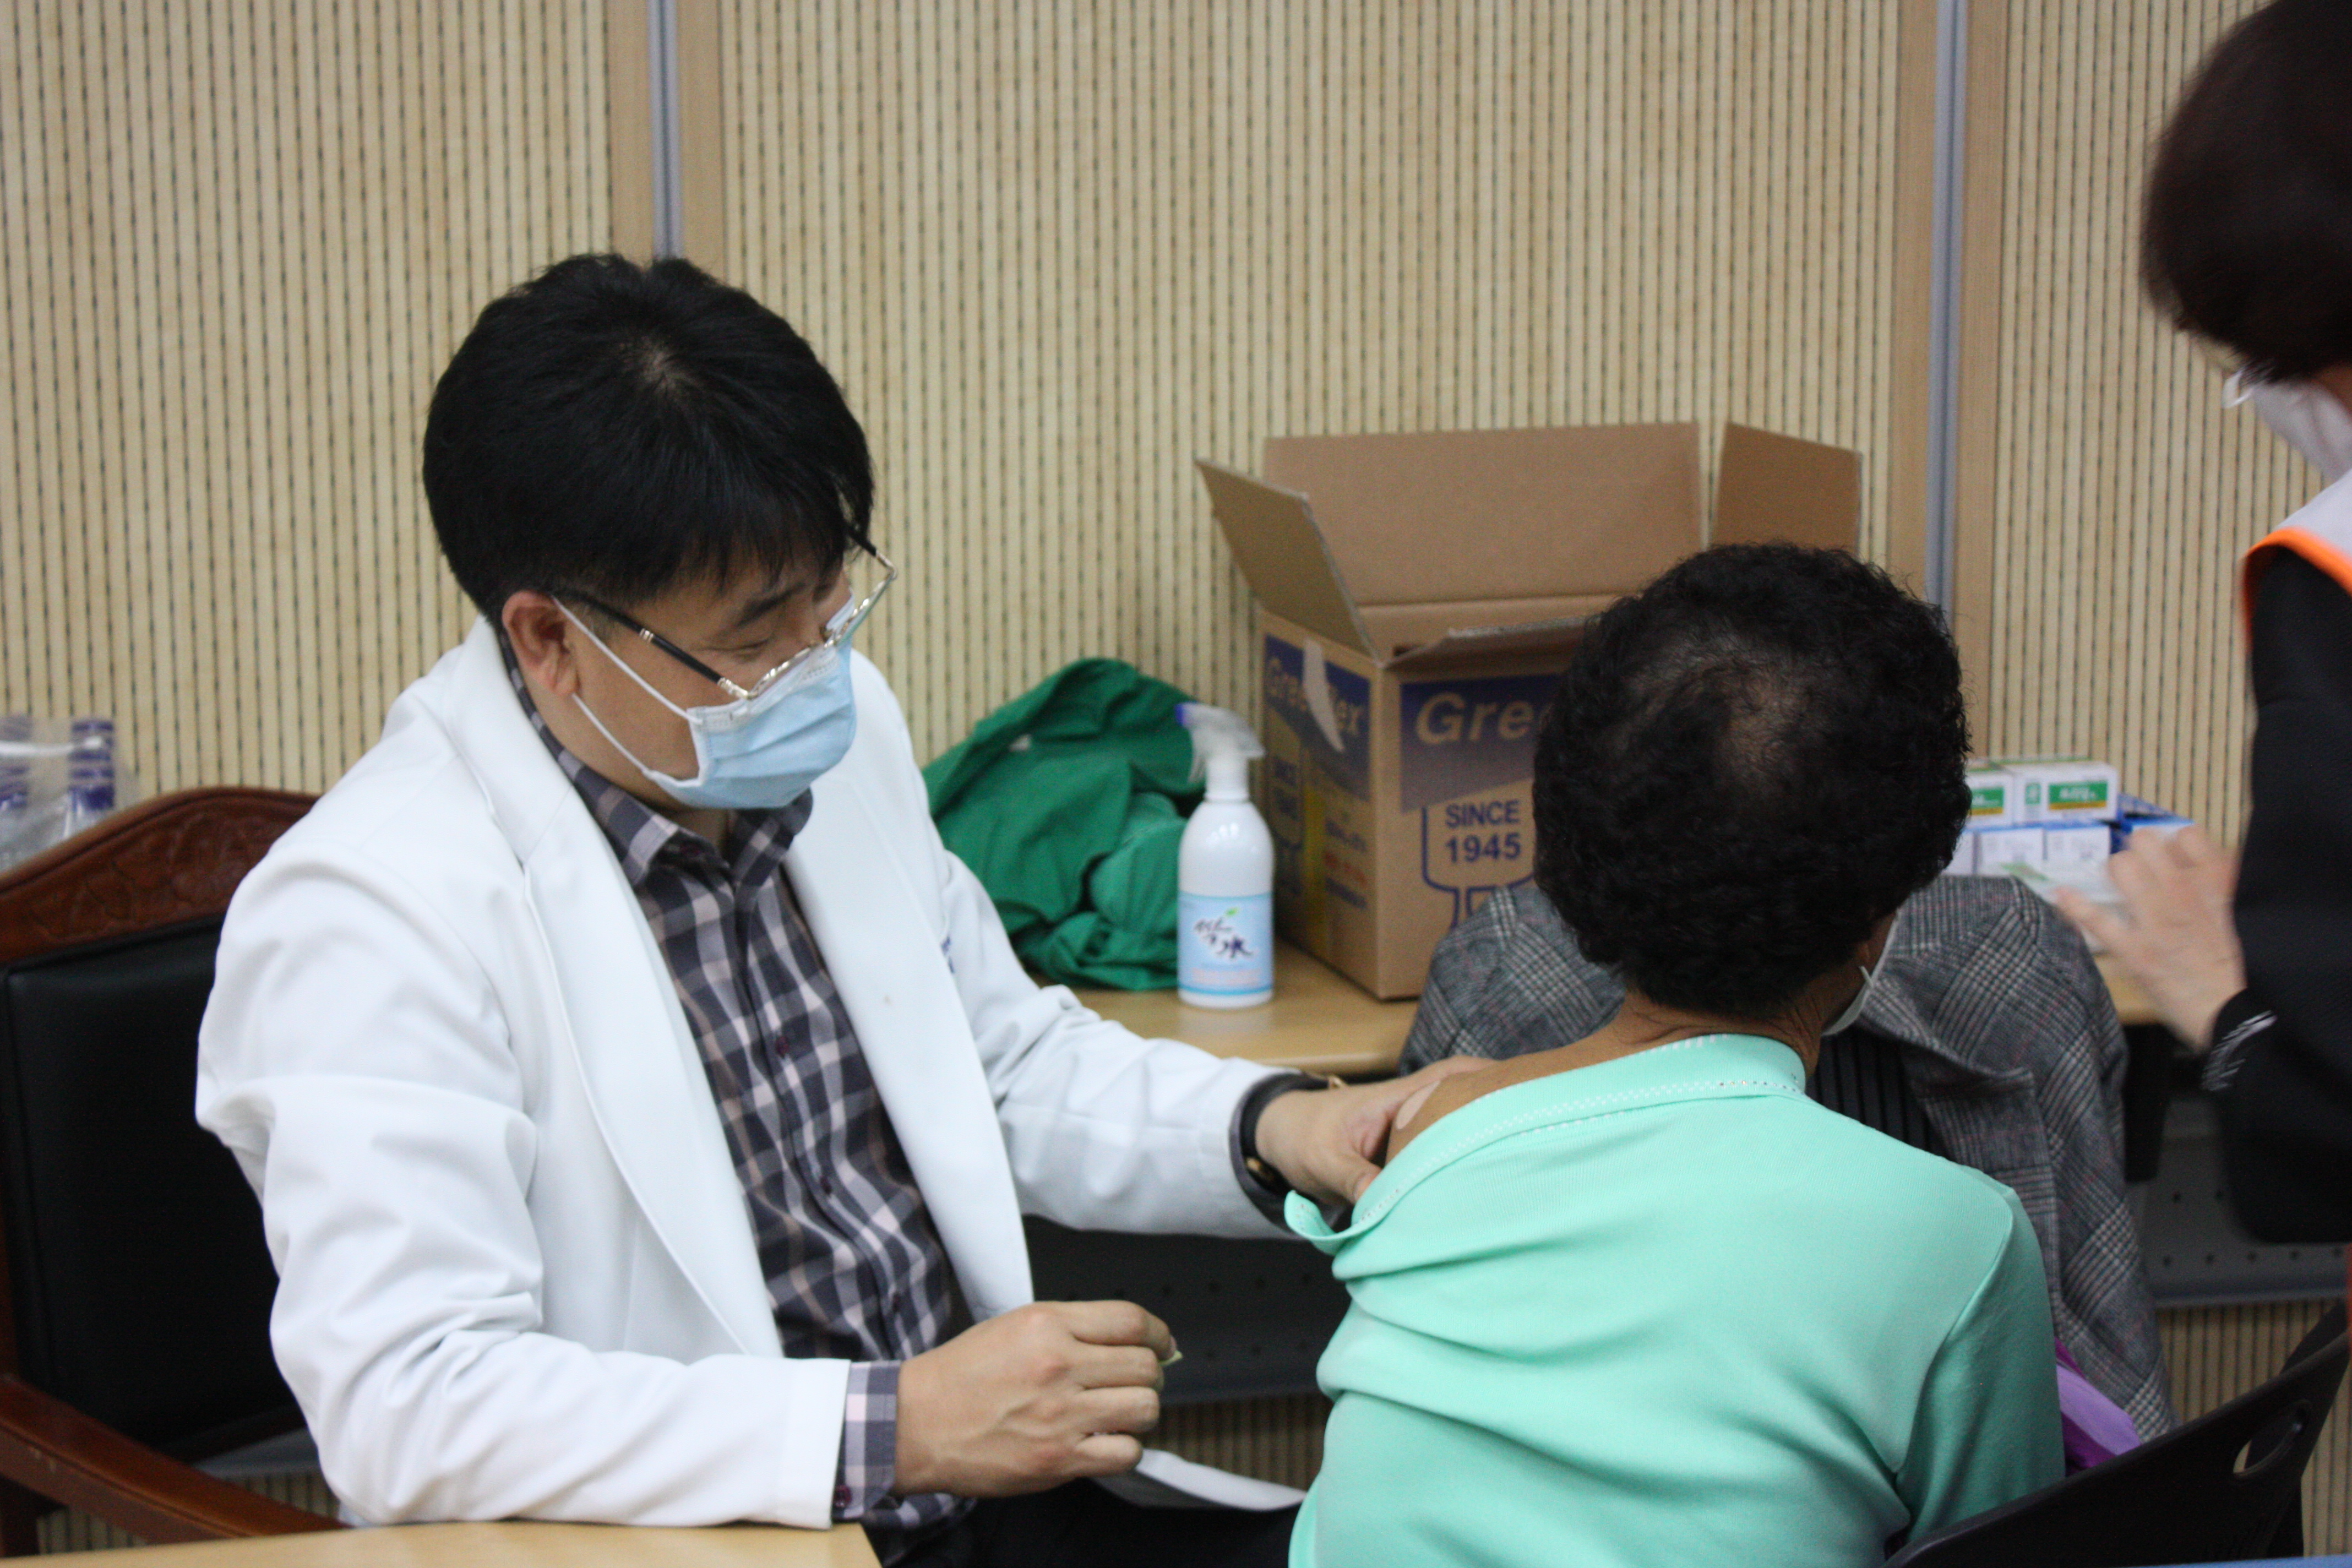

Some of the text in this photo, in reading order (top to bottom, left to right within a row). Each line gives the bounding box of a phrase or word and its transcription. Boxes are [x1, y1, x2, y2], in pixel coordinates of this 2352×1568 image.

[1416, 692, 1552, 744] Gre
[1445, 799, 1520, 829] SINCE
[1445, 832, 1521, 863] 1945
